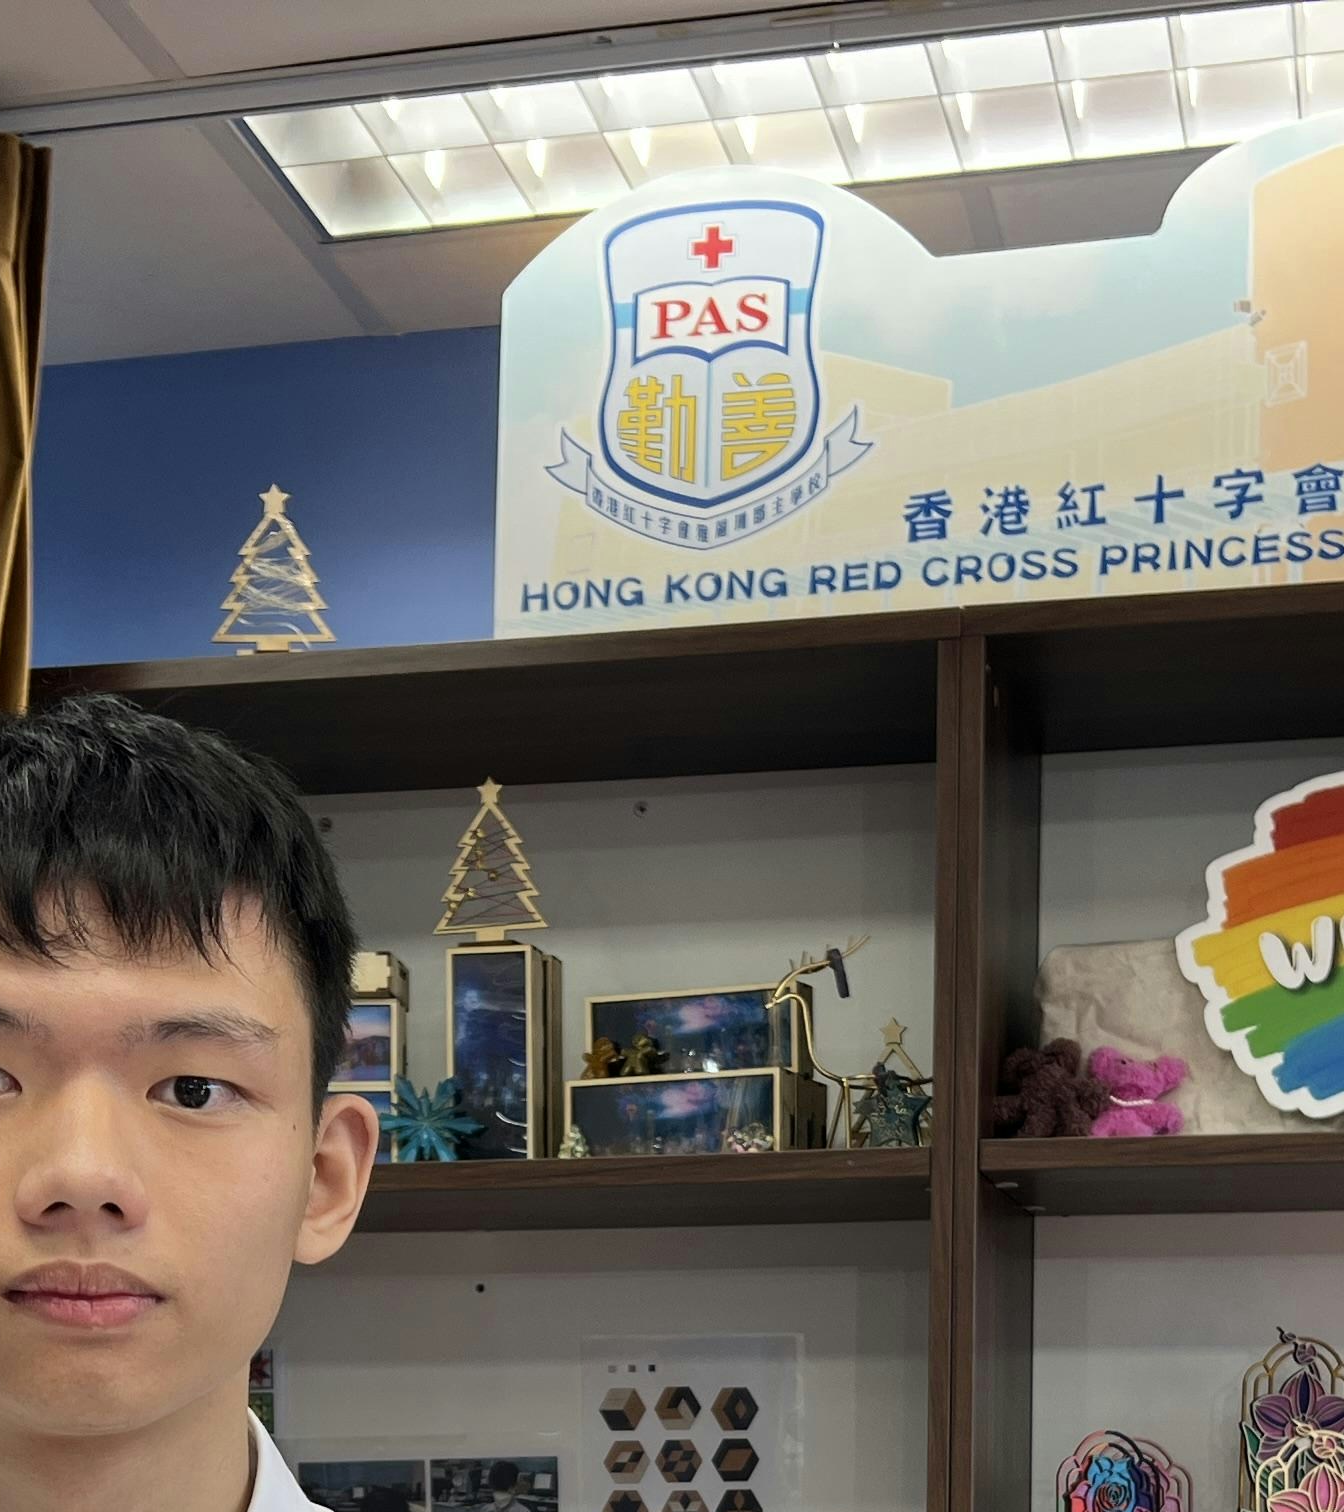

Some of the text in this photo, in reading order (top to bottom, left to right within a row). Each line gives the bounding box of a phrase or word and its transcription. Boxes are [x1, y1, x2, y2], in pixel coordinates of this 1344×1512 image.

[651, 293, 769, 340] PAS
[521, 577, 645, 612] HONG
[664, 567, 788, 603] KONG
[808, 560, 903, 595] RED
[921, 547, 1079, 587] CROSS
